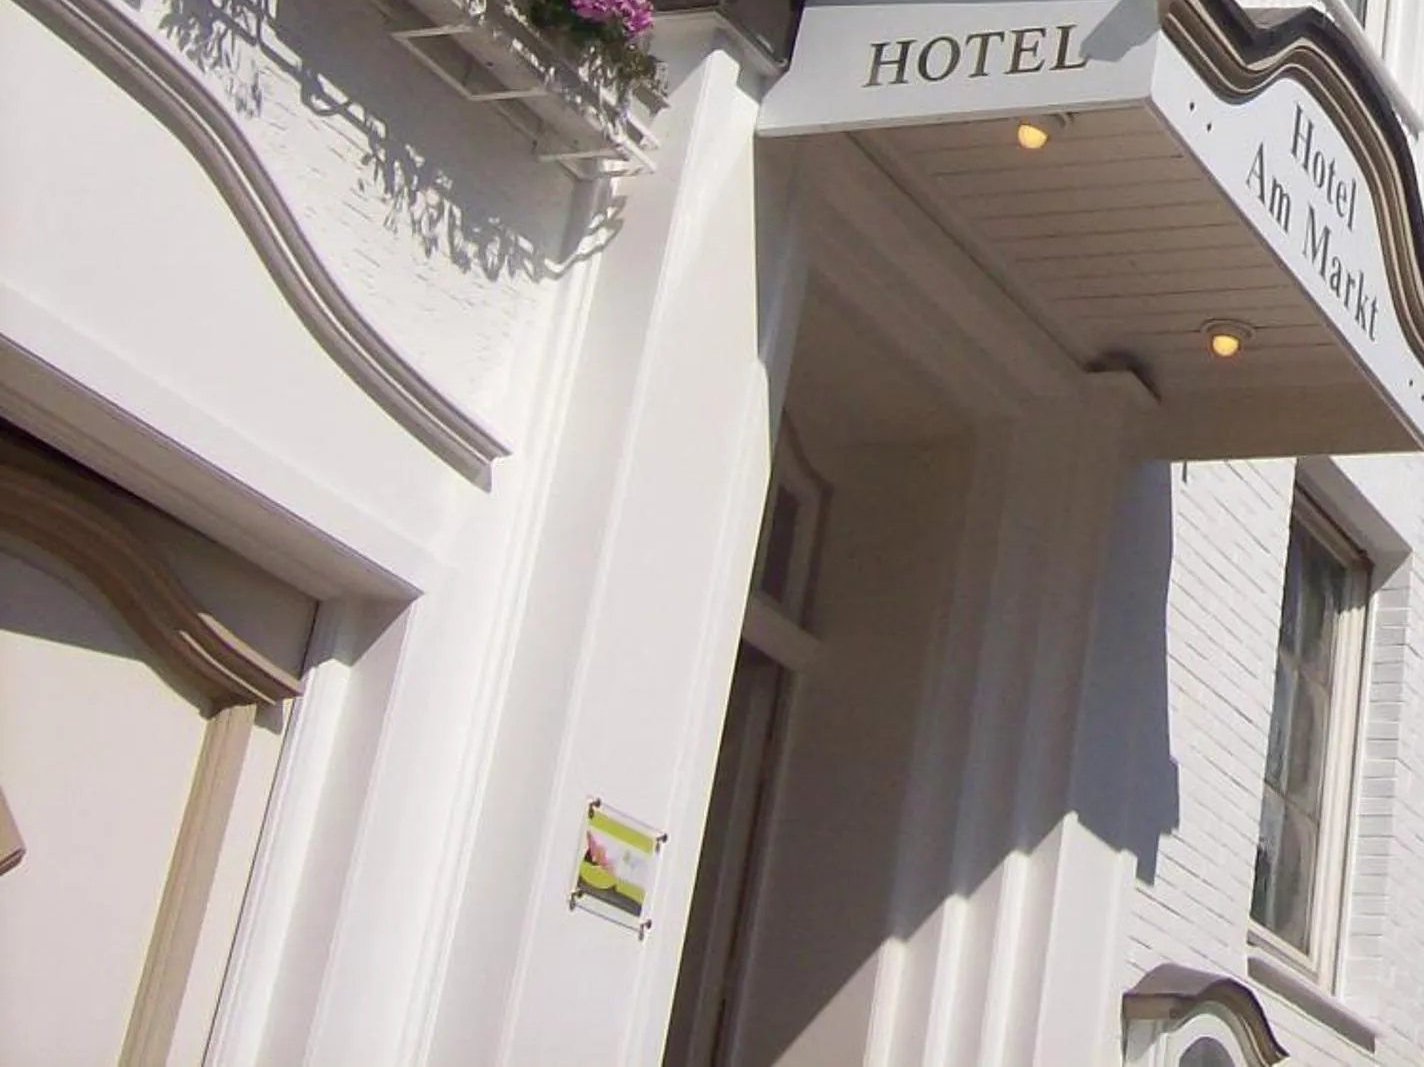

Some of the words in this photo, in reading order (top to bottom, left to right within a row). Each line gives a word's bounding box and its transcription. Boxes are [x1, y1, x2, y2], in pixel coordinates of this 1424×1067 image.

[861, 24, 1089, 88] HOTEL
[1290, 102, 1357, 230] Hotel
[1246, 141, 1292, 234] Am
[1302, 204, 1379, 343] Markt
